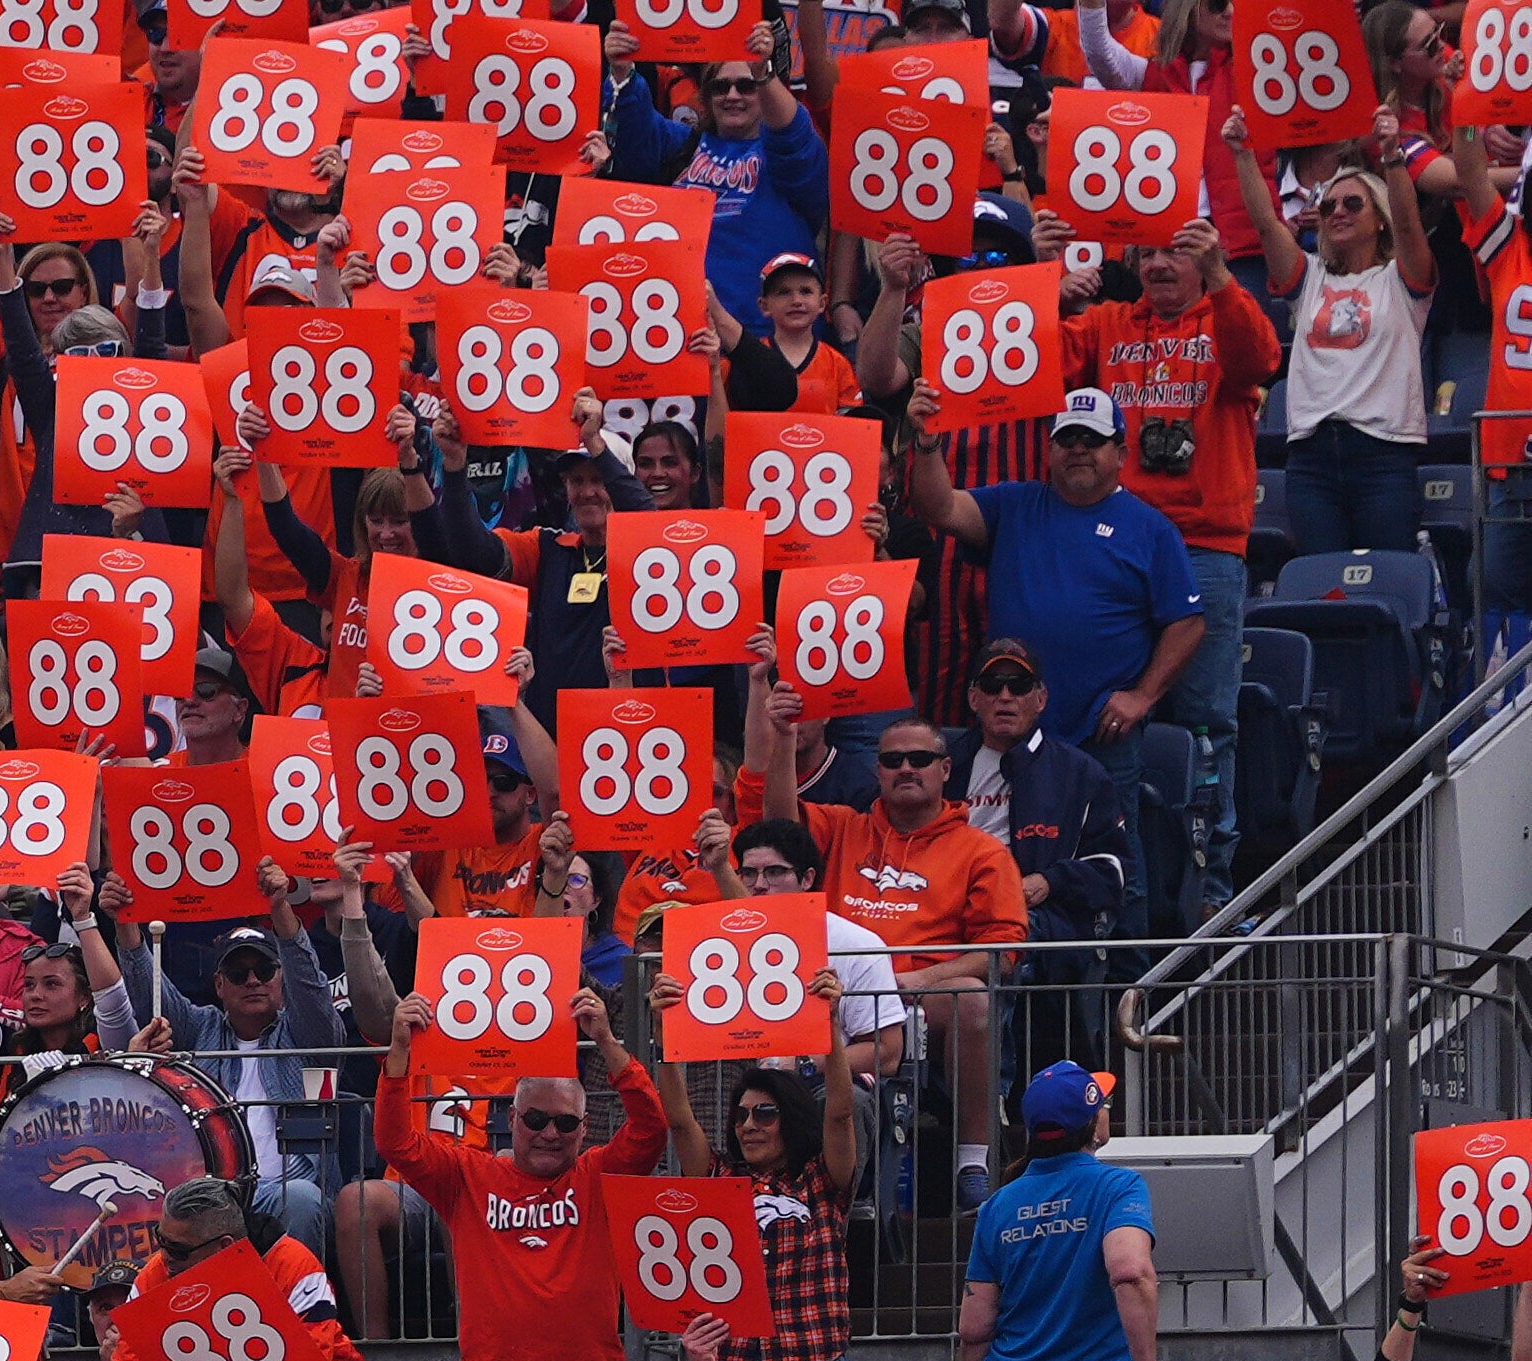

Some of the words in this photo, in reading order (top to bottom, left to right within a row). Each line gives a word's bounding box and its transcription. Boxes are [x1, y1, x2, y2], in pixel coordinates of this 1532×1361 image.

[1470, 6, 1532, 91] 88
[209, 73, 319, 157] 88
[850, 129, 954, 221] 88
[1072, 396, 1097, 412] ny
[1109, 380, 1209, 407] BRONCOS
[1348, 567, 1368, 581] 17
[796, 595, 884, 685] 88
[843, 894, 920, 916] BRONCOS
[436, 953, 553, 1041] 88
[13, 1100, 82, 1148] DENVER
[89, 1096, 179, 1136] BRONCOS
[486, 1189, 579, 1230] BRONCOS
[1016, 1198, 1072, 1222] GUEST
[1000, 1217, 1089, 1244] RELATIONS
